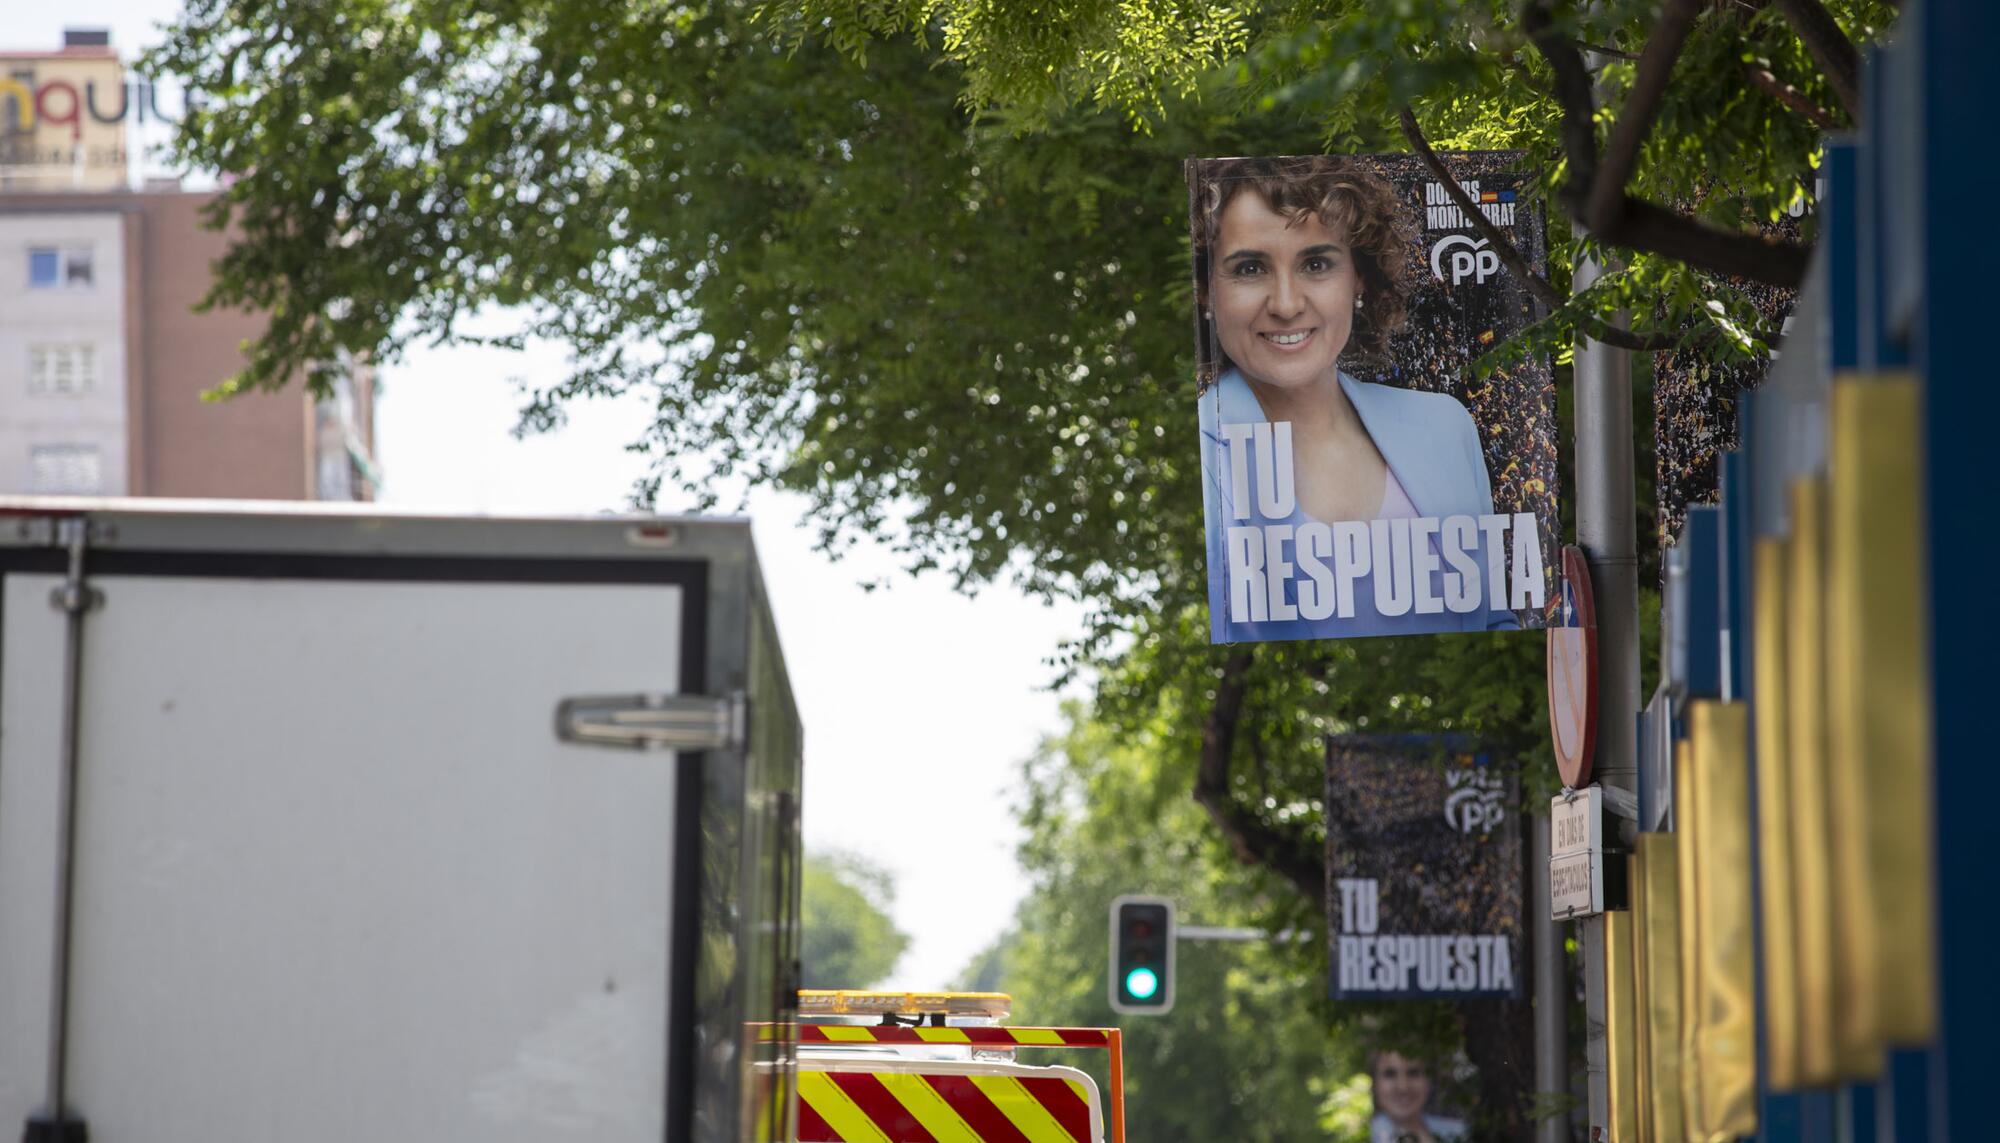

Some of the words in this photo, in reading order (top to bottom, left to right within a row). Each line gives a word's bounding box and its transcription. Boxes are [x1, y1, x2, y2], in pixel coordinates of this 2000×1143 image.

[1222, 421, 1295, 520] TU
[1227, 512, 1545, 623] RESPUESTA
[1338, 878, 1378, 933] TU
[1338, 934, 1513, 992] RESPUESTA
